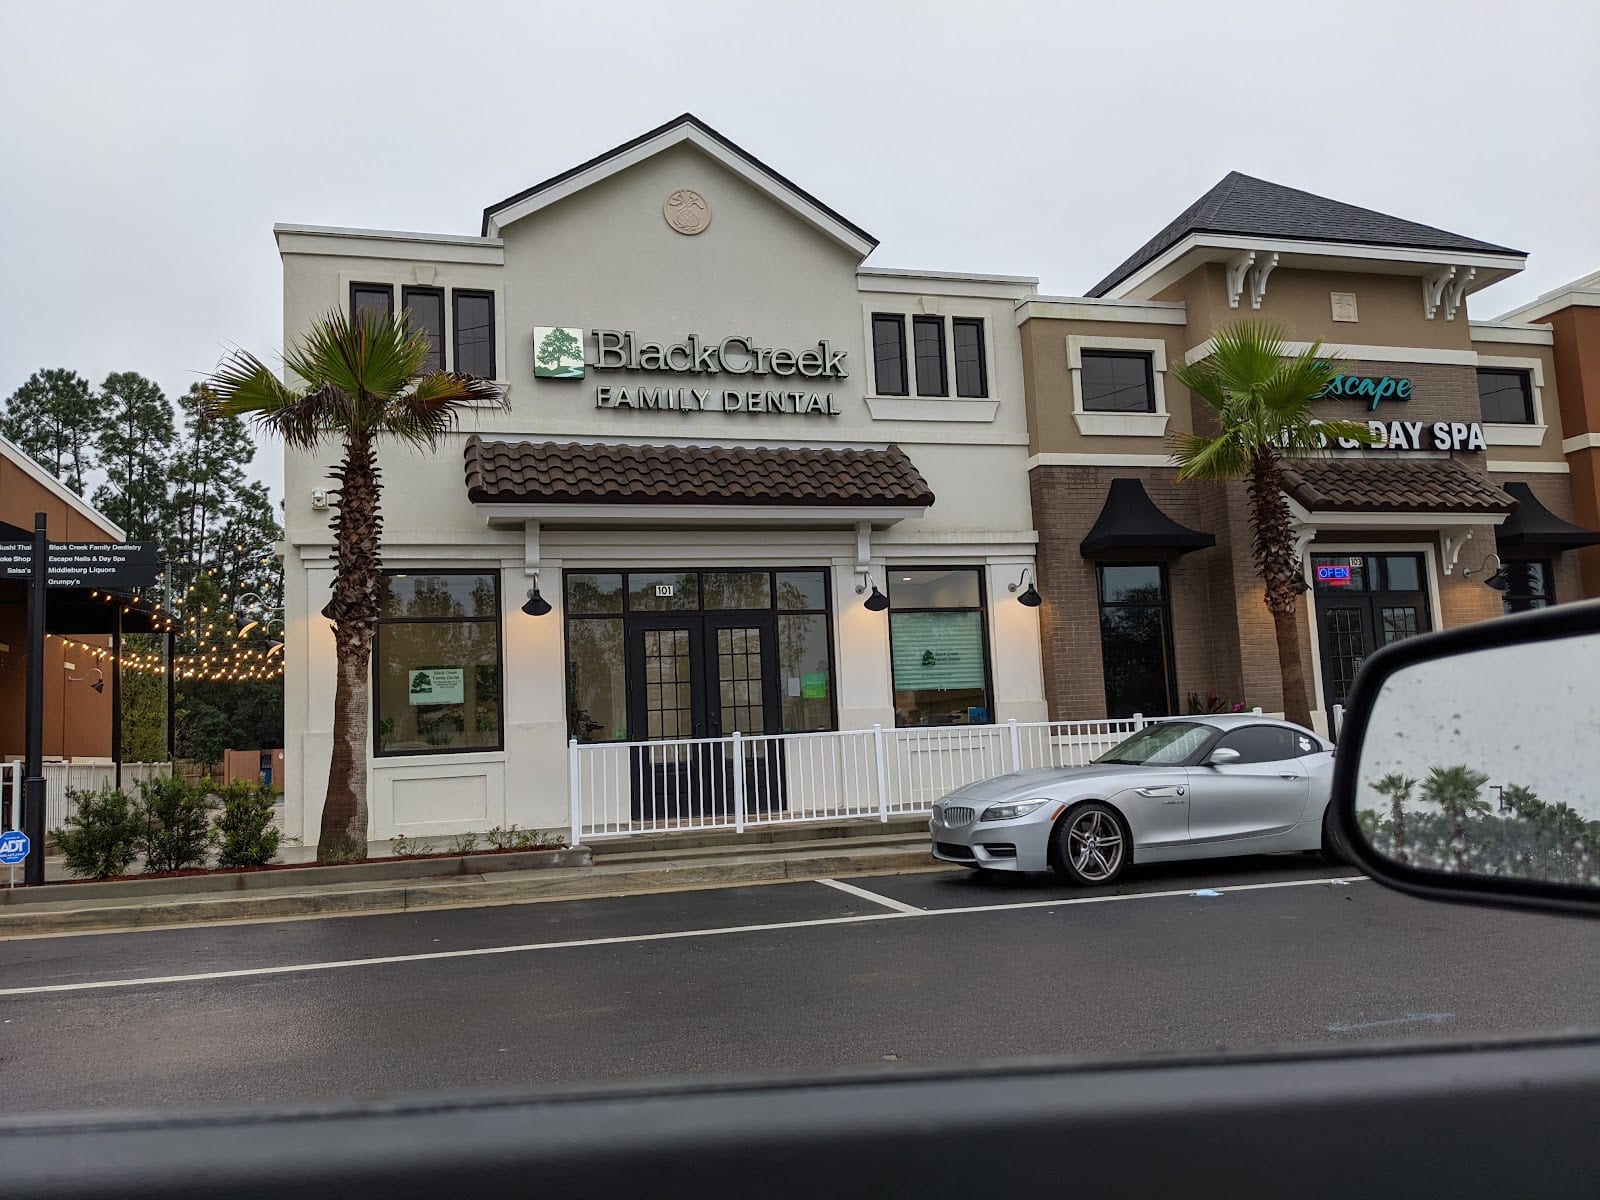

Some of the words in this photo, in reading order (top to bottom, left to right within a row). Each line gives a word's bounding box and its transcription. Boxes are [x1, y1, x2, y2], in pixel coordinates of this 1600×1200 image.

[591, 328, 849, 378] BlackCreek
[595, 384, 711, 412] FAMILY
[722, 388, 842, 416] DENTAL
[1367, 420, 1424, 451] DAY
[1434, 421, 1488, 451] SPA
[89, 544, 111, 552] Family
[112, 544, 142, 552] Dentistry
[13, 555, 32, 563] Shop
[48, 555, 73, 563] Escape
[112, 555, 126, 563] Spa
[1350, 558, 1362, 566] 103
[1319, 567, 1349, 578] OPEN
[657, 586, 671, 595] 101
[0, 839, 26, 853] ADT
